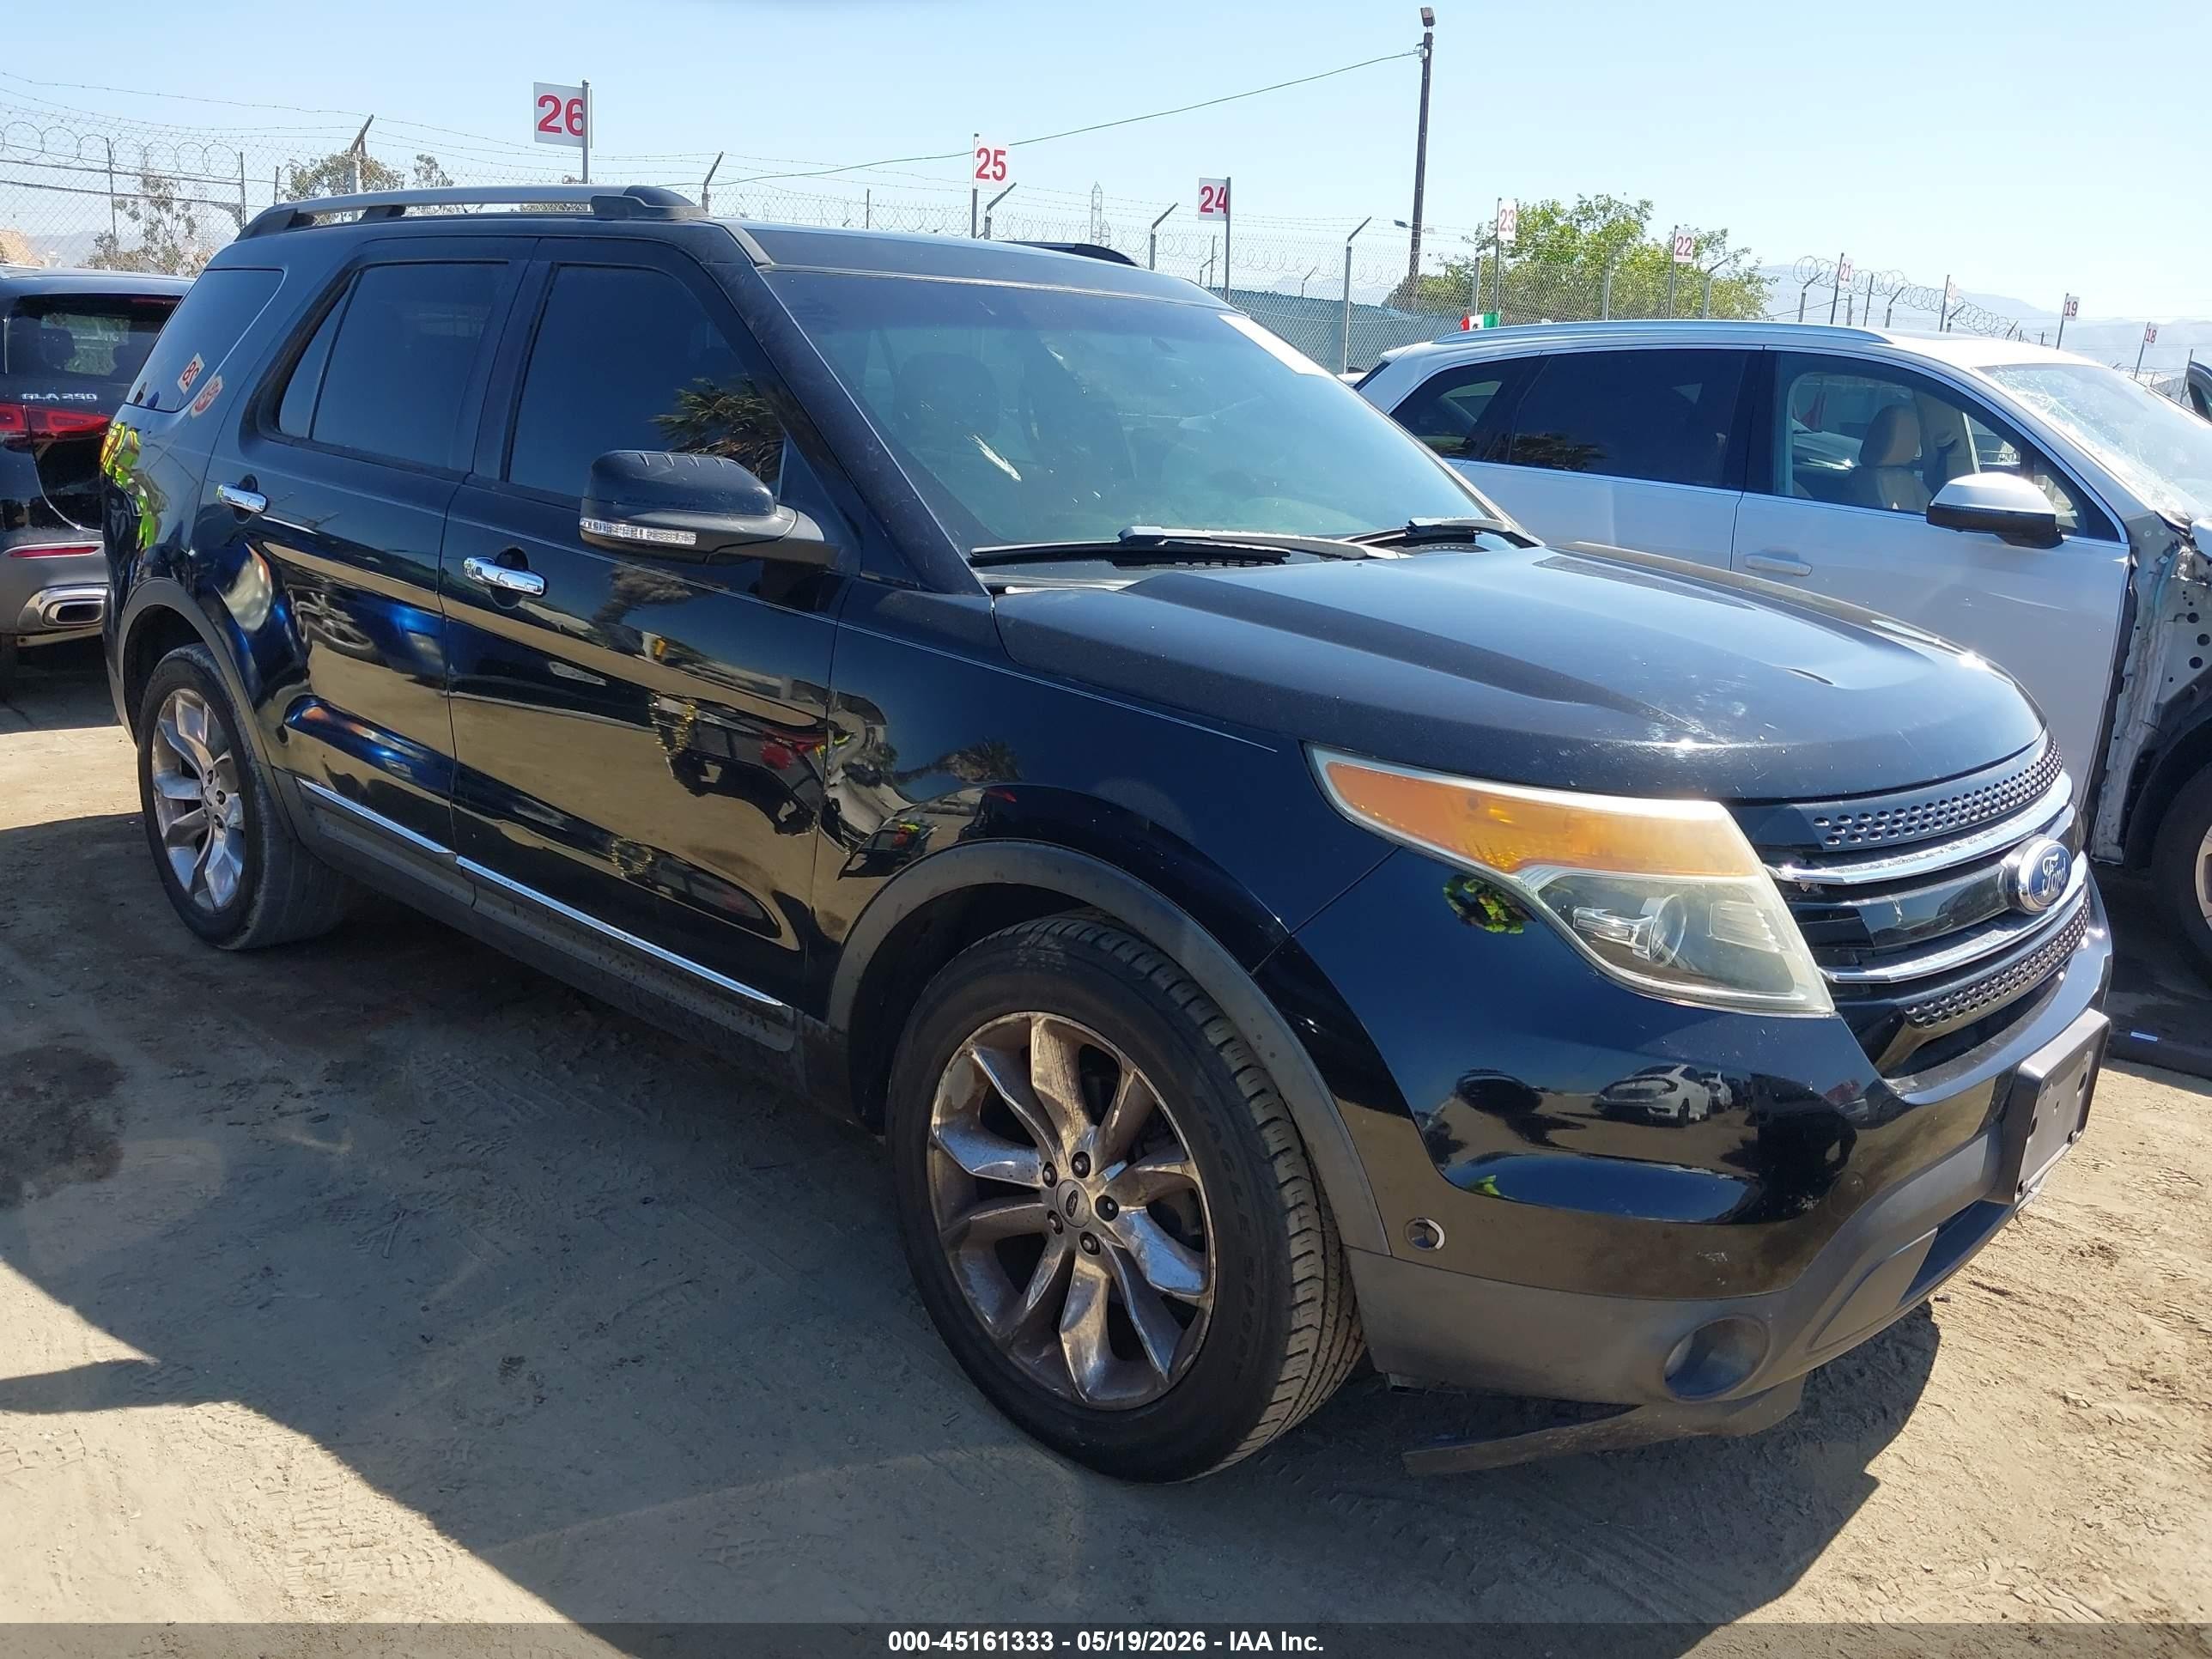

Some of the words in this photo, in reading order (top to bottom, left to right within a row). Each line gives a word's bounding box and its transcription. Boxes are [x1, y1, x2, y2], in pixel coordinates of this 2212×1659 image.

[538, 94, 583, 137] 26
[975, 148, 1006, 181] 25
[1200, 185, 1227, 214] 24
[1499, 209, 1515, 233] 23
[1674, 236, 1692, 257] 22
[1839, 262, 1851, 283] 21
[2063, 301, 2078, 317] 19
[2145, 328, 2157, 343] 18
[21, 392, 59, 401] GLA
[62, 392, 98, 402] 250
[2042, 852, 2068, 896] Ford
[1194, 1095, 1251, 1238] EAGLE
